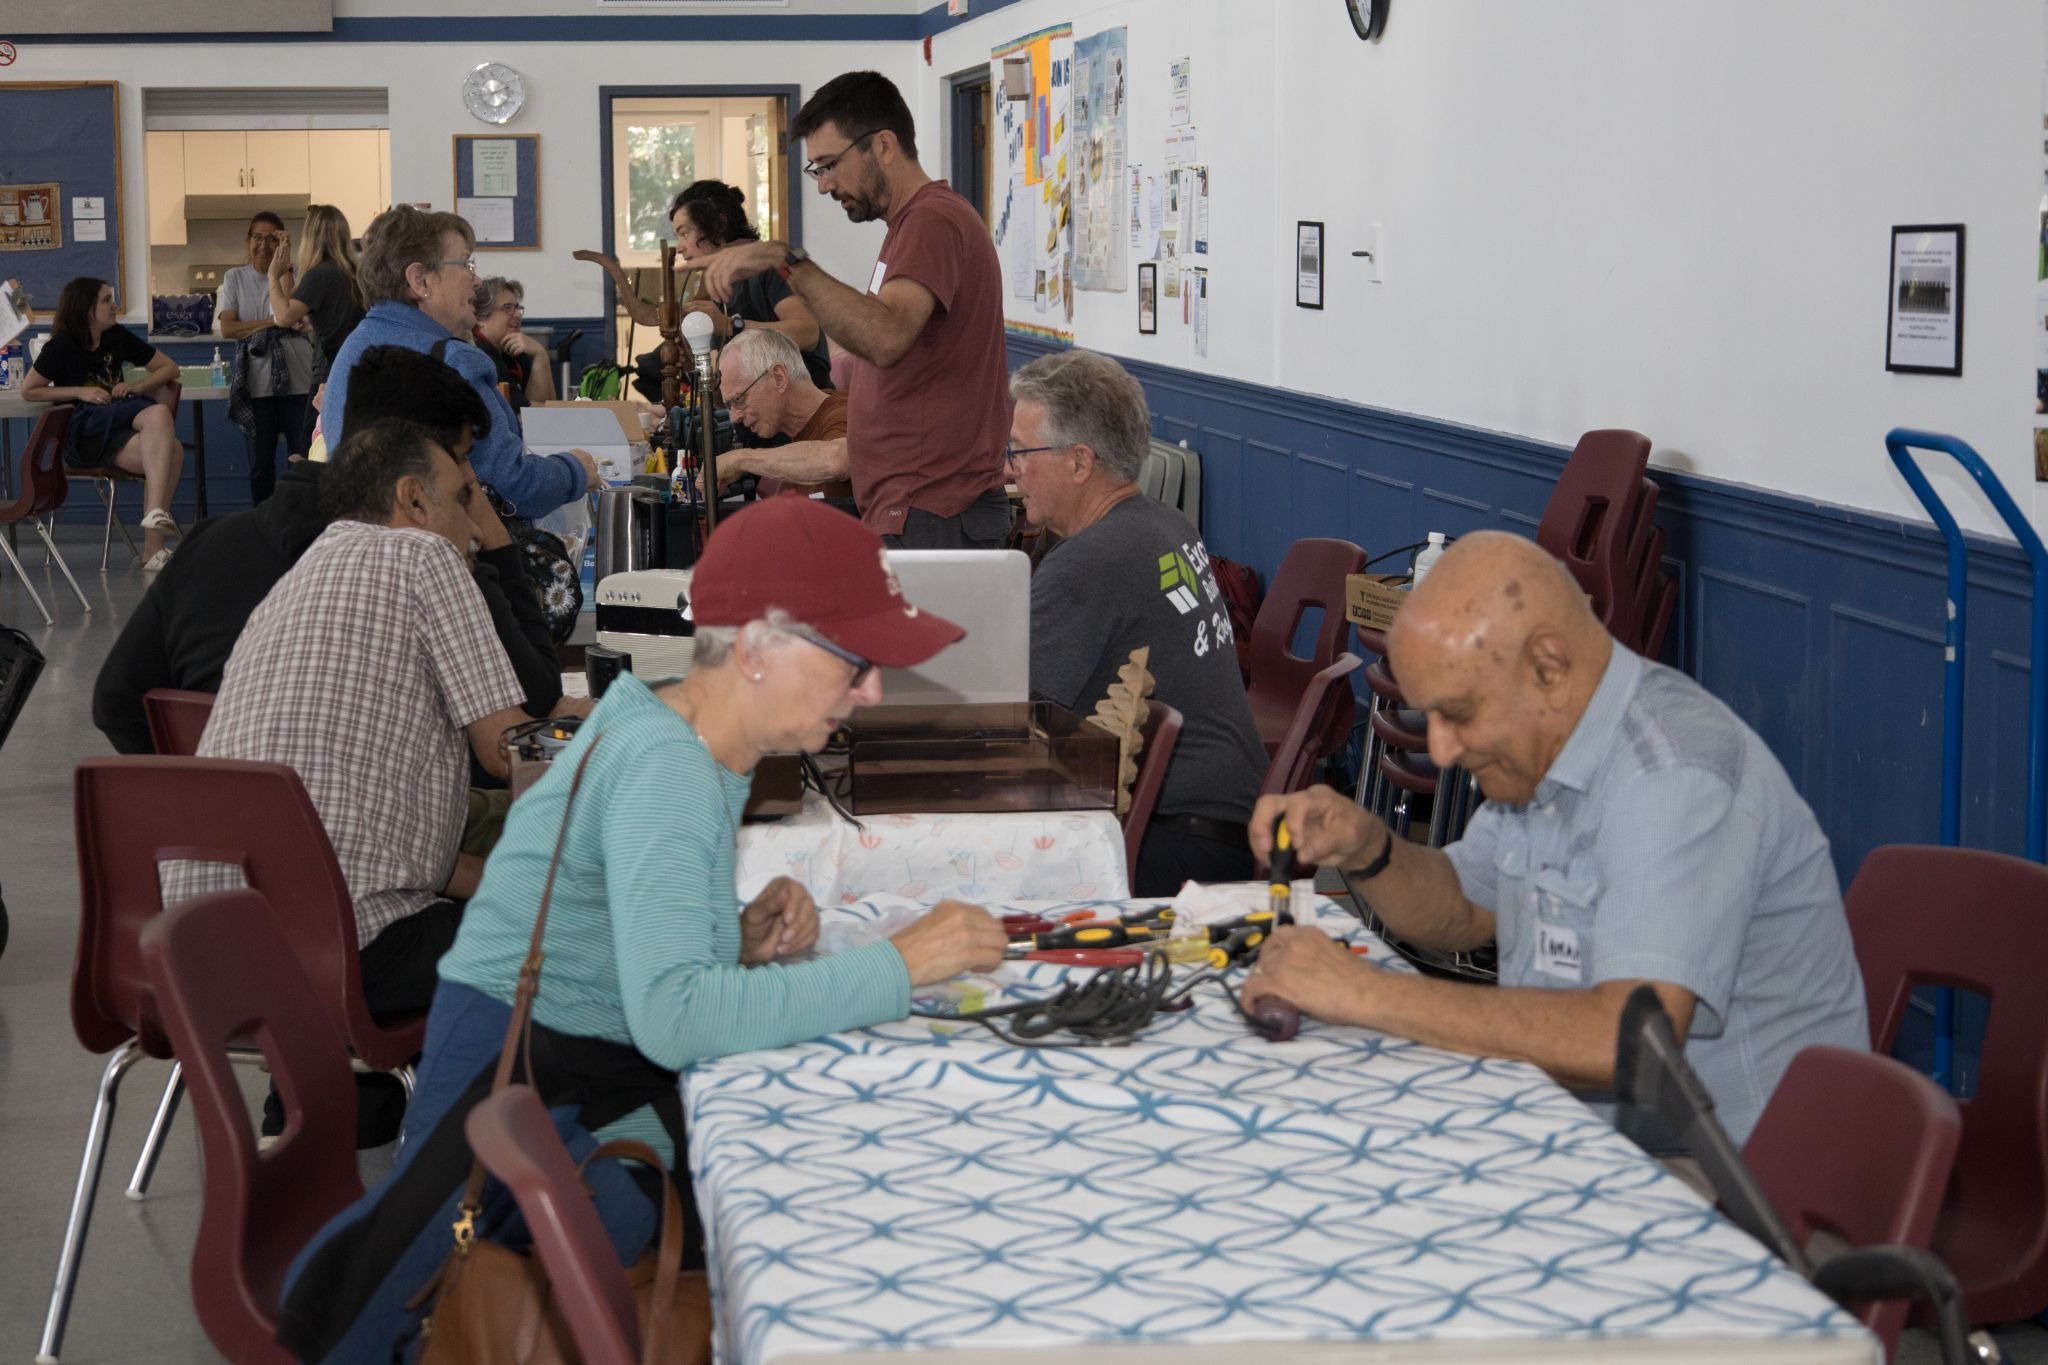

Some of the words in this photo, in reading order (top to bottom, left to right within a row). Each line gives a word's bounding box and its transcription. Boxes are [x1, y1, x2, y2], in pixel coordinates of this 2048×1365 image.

[1051, 60, 1062, 88] JOIN
[1063, 58, 1070, 86] US
[166, 310, 192, 320] eska
